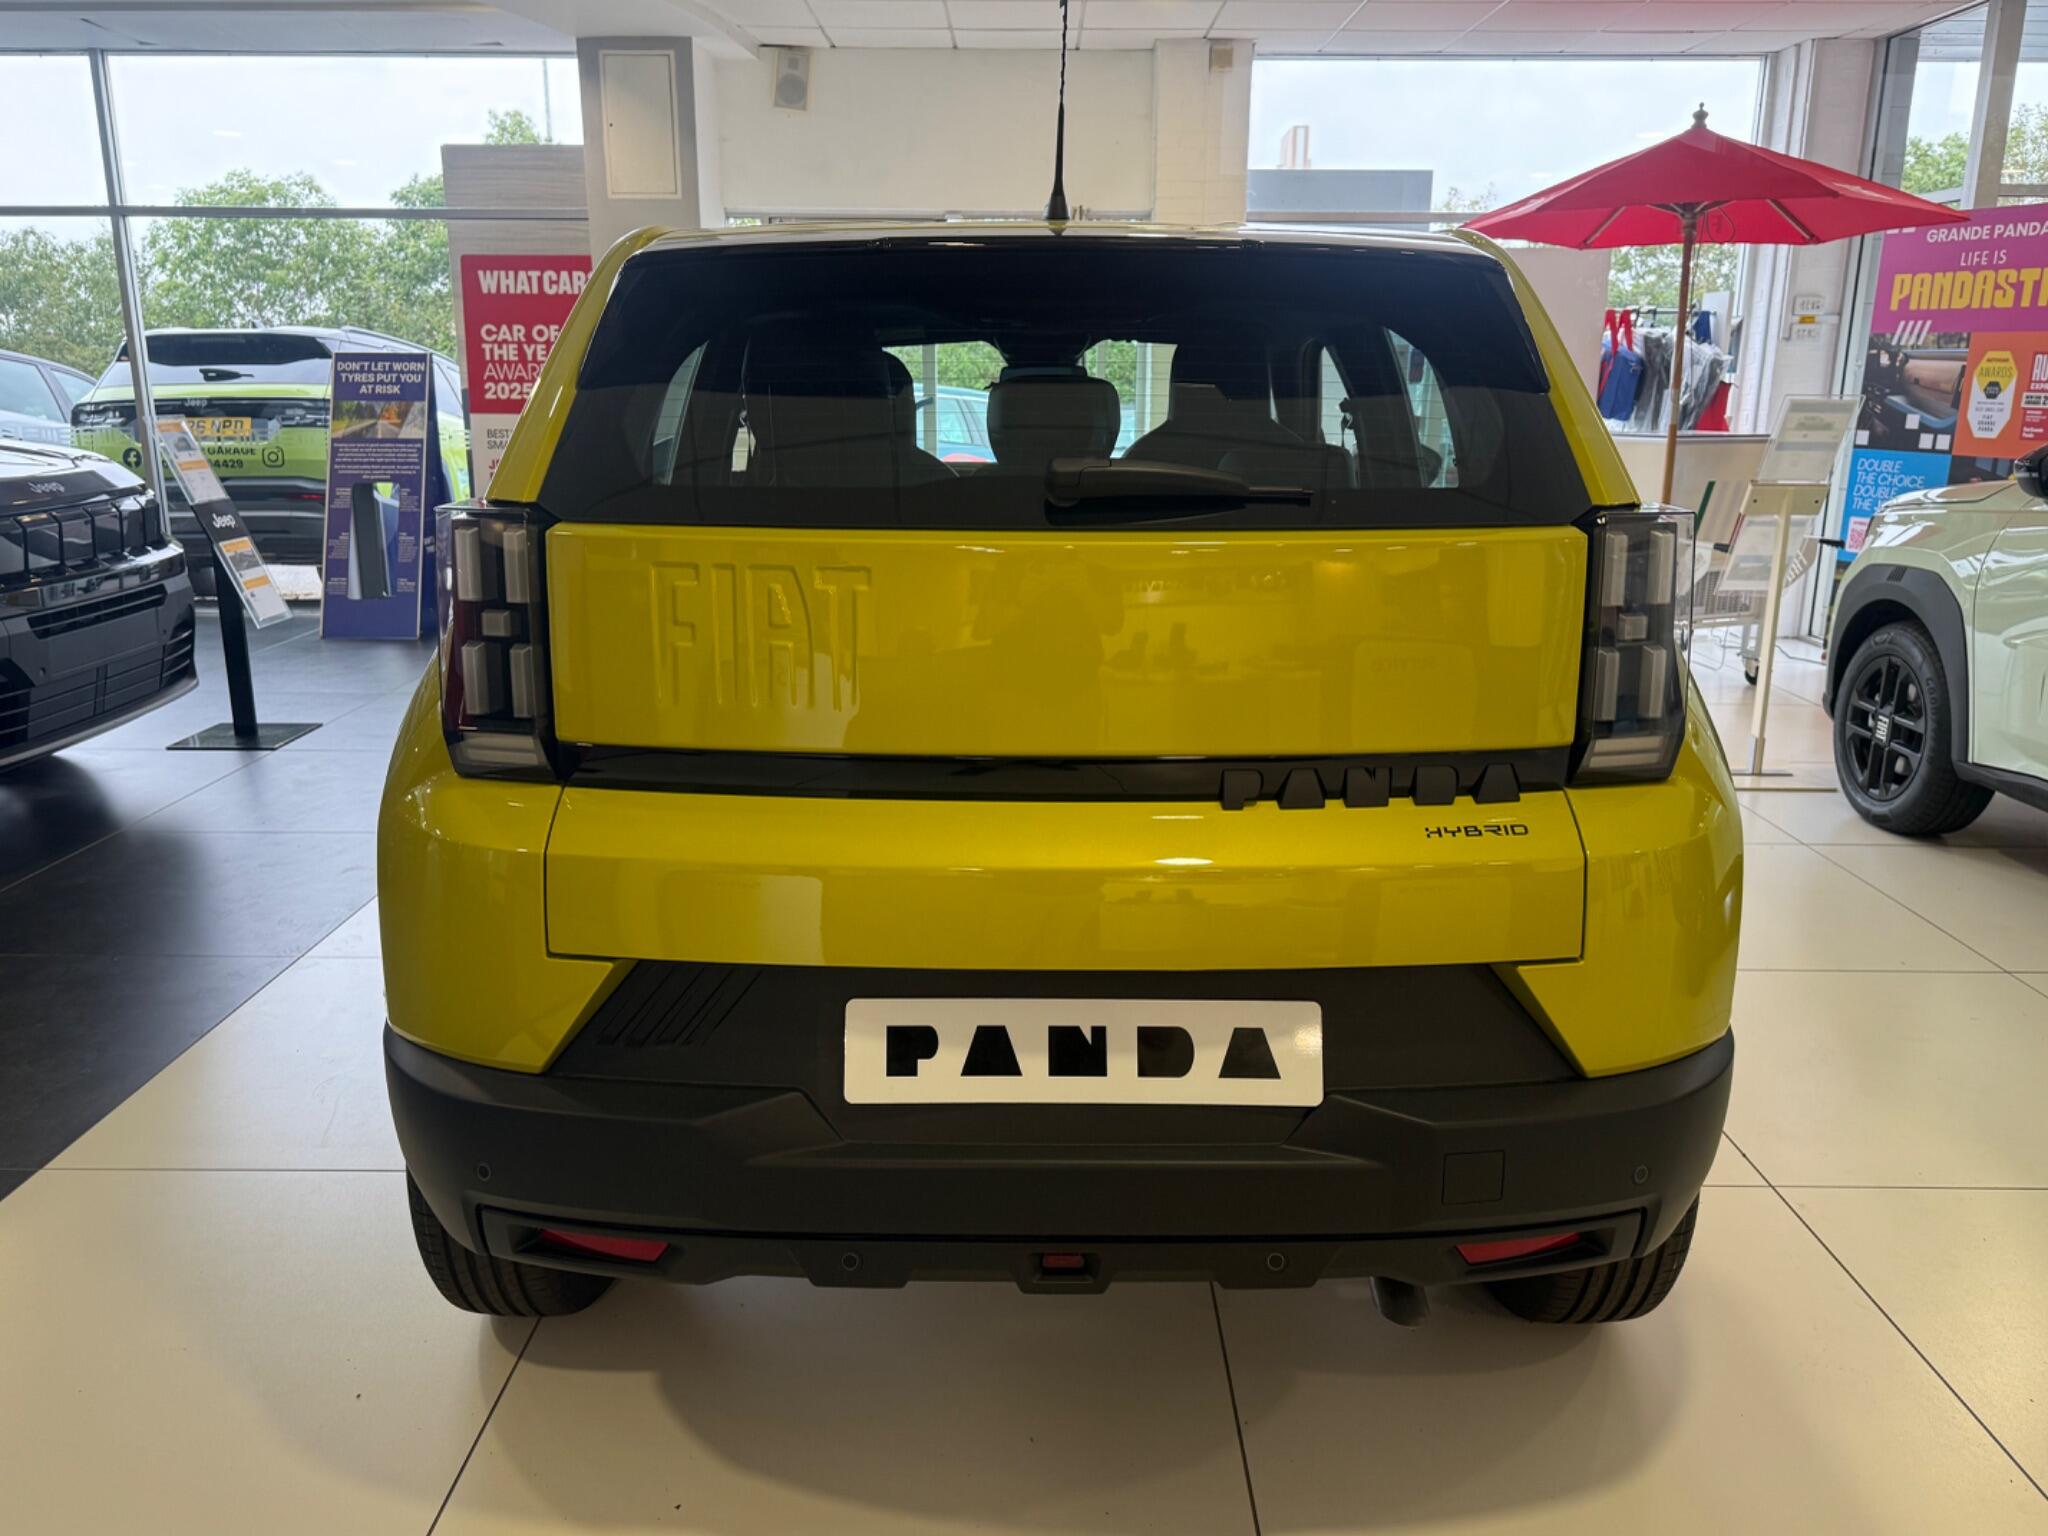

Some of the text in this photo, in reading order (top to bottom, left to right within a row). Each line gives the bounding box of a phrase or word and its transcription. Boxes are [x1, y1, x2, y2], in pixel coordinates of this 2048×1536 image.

[1926, 221, 2048, 243] GRANDE PANDA
[1960, 249, 2008, 267] LIFE IS
[480, 324, 561, 342] CAR OF
[482, 343, 548, 361] THE YE
[337, 361, 426, 372] DON'T LET WORN
[341, 373, 421, 383] TYRES PUT YOU
[359, 384, 401, 394] AT RISK
[484, 382, 534, 399] 2025
[1857, 458, 1903, 473] DOUBLE
[1857, 471, 1926, 489] THE CHOICE
[1853, 484, 1899, 499] DOUBLE
[1853, 497, 1873, 511] THE
[211, 512, 237, 529] Jeep
[650, 561, 872, 713] FIAT
[1218, 762, 1522, 811] PANDA
[1424, 823, 1530, 839] HYBRID
[886, 1025, 1282, 1079] PANDA
